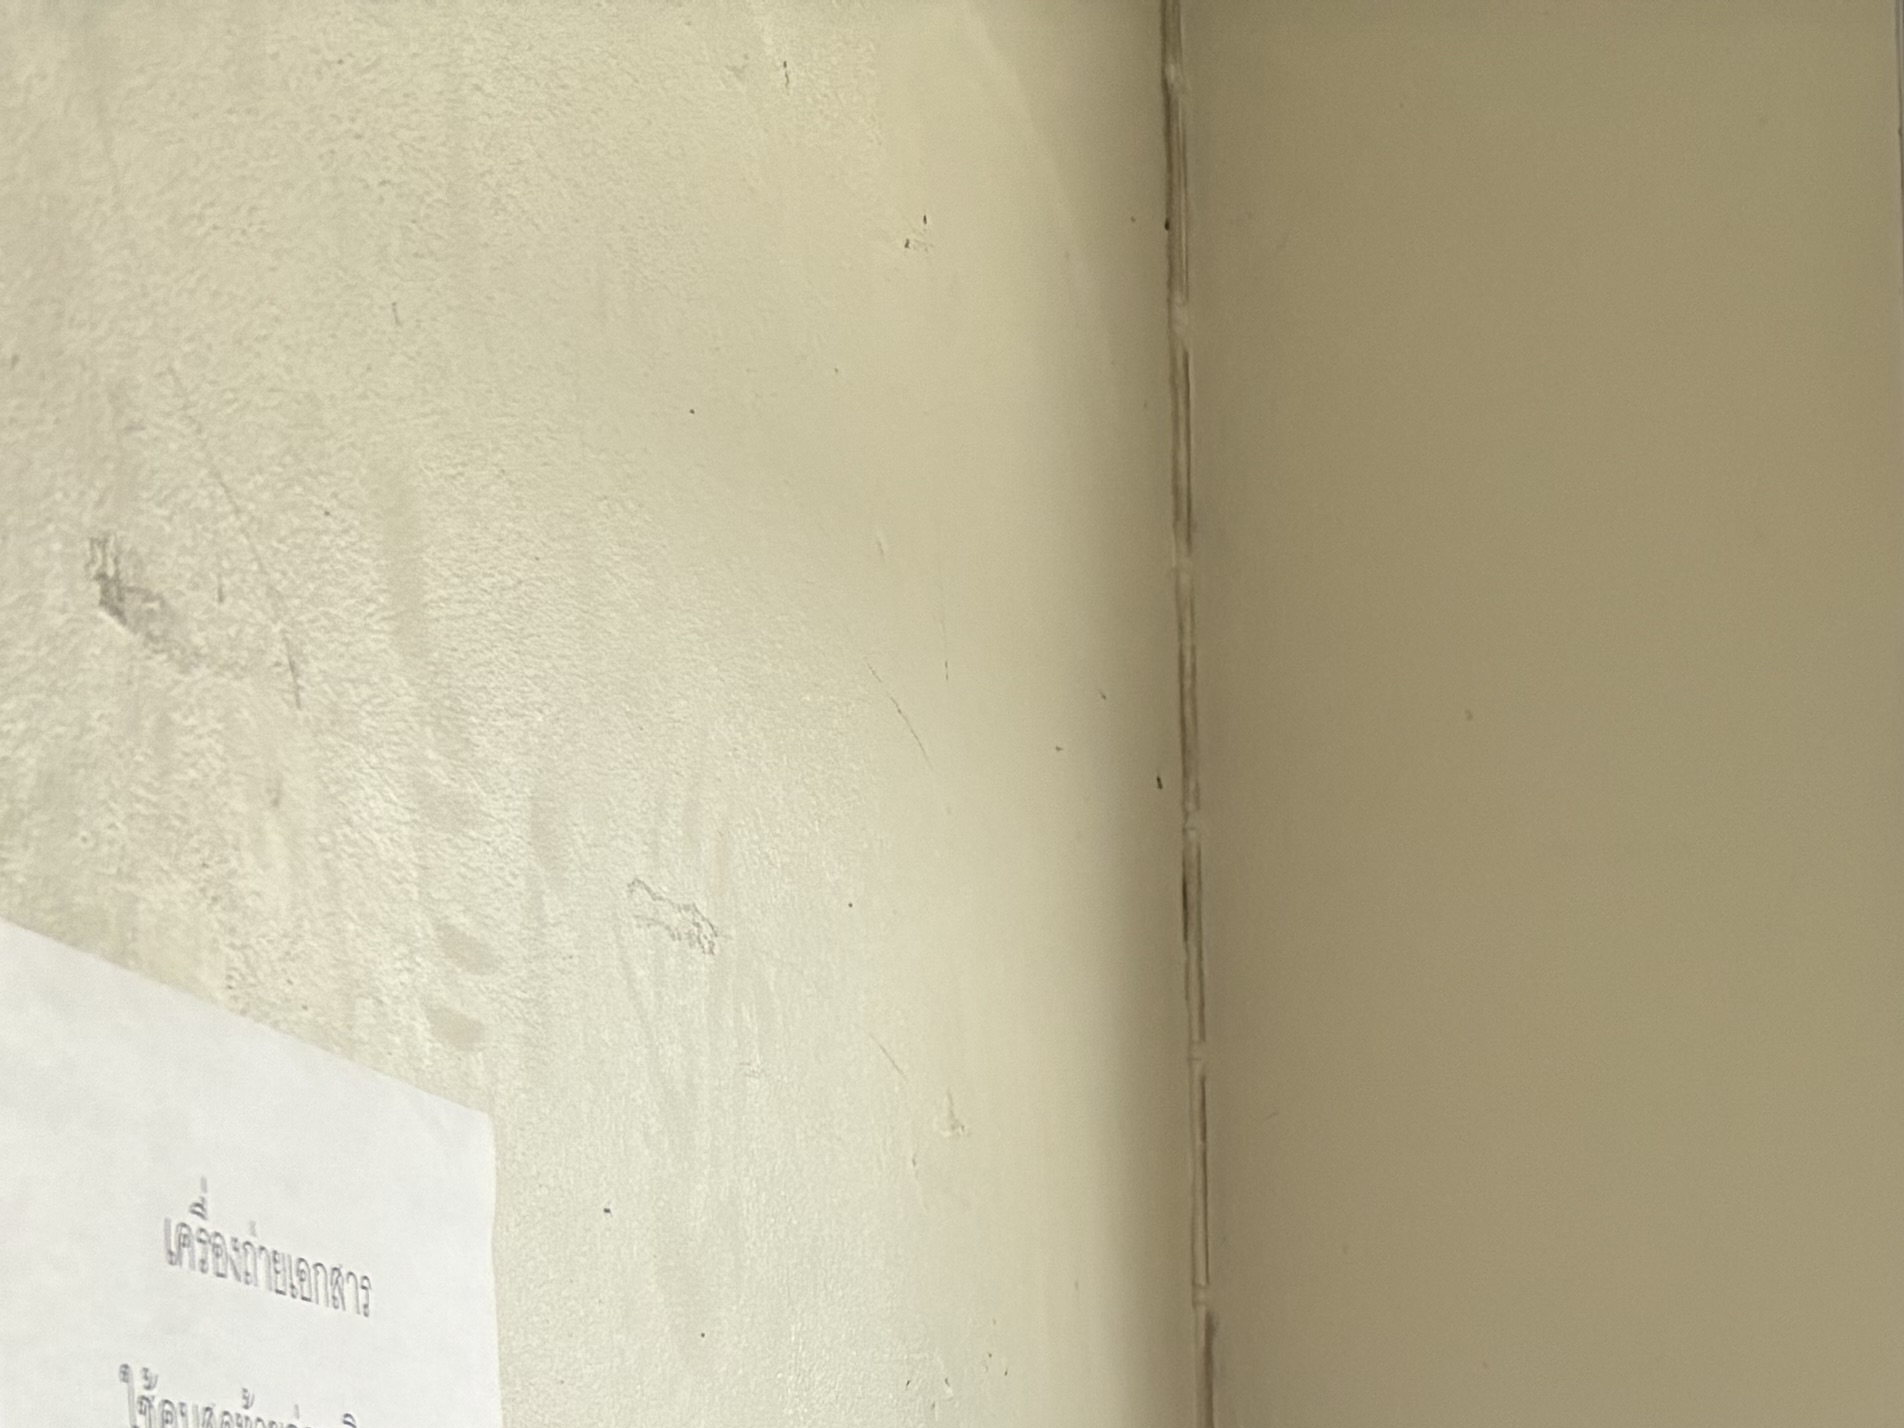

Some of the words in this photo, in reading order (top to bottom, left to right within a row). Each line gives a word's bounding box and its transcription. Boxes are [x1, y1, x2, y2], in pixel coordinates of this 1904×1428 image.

[163, 1176, 373, 1318] เครื่องถ่ายเอกสาร
